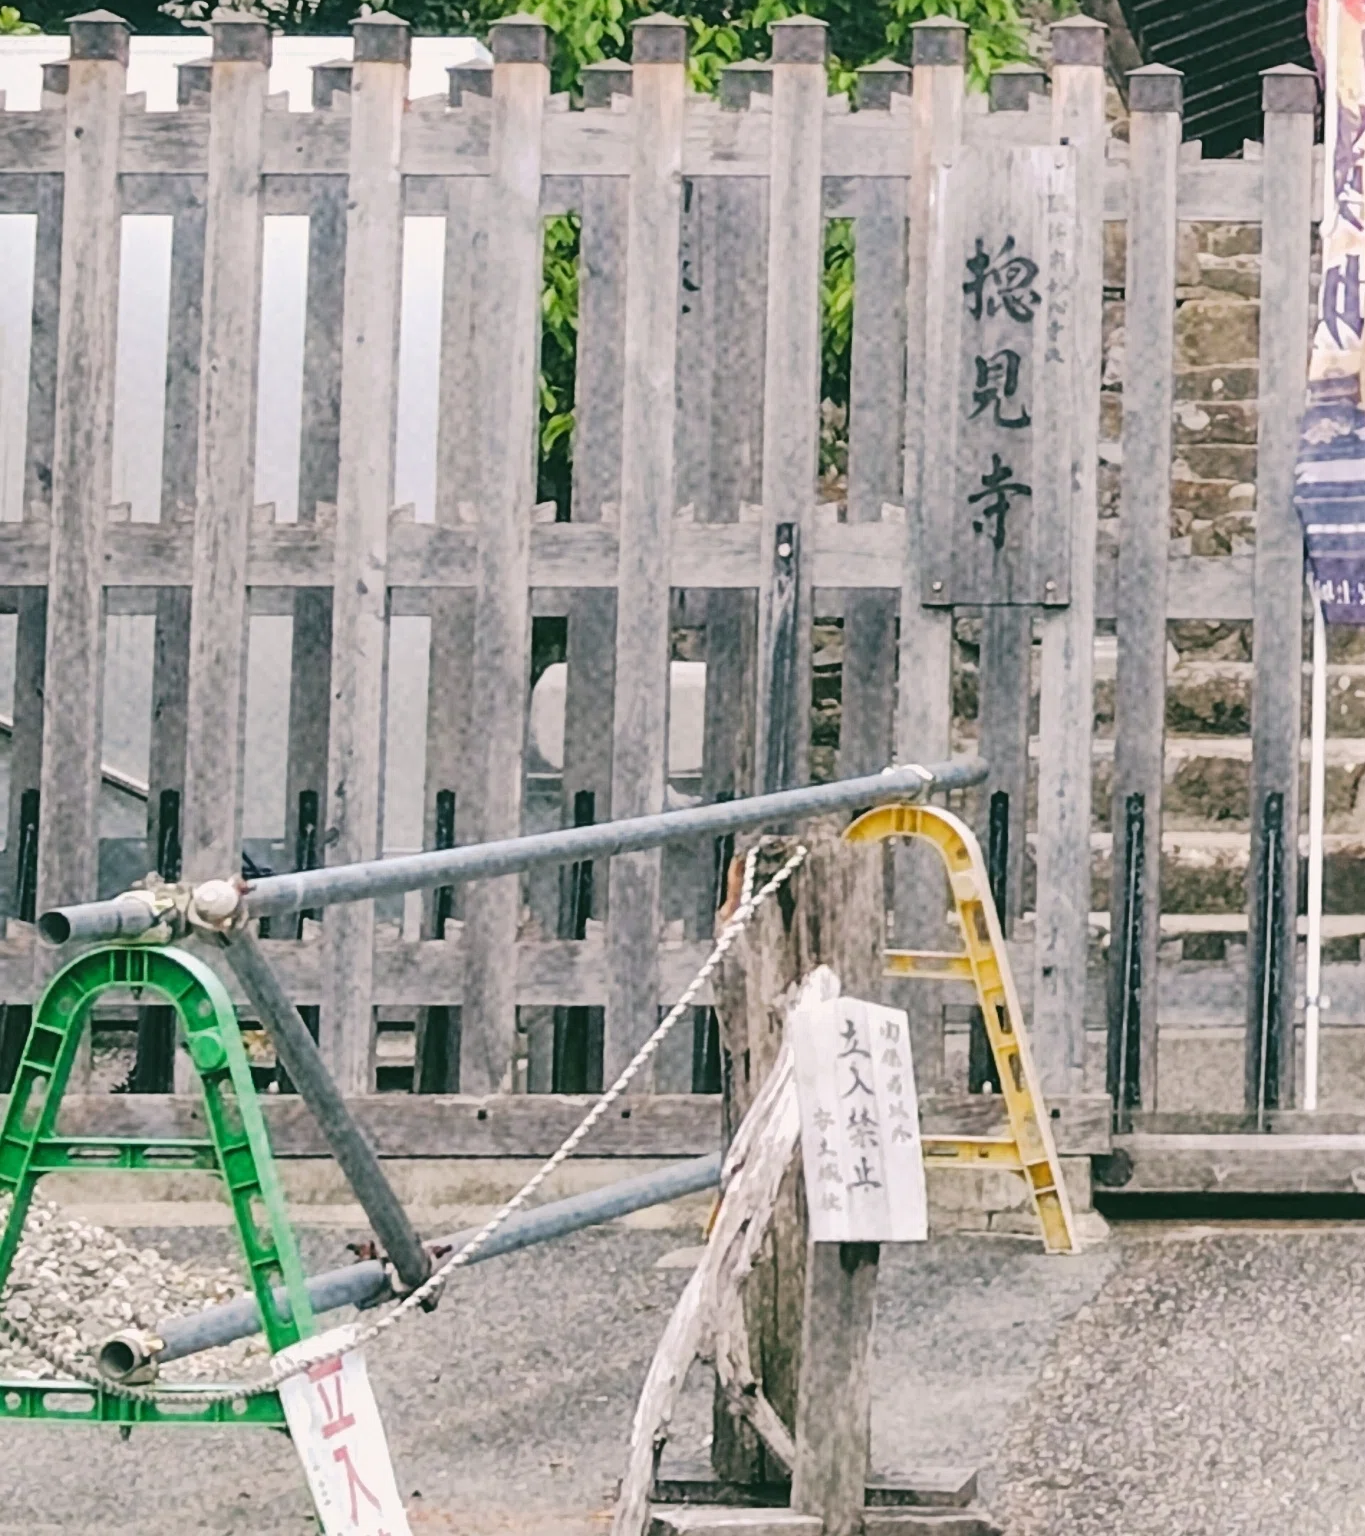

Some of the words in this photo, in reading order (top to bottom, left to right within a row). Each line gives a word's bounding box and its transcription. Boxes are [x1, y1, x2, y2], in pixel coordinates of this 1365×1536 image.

[837, 1018, 883, 1191] 立入禁止
[305, 1354, 394, 1536] 立入
